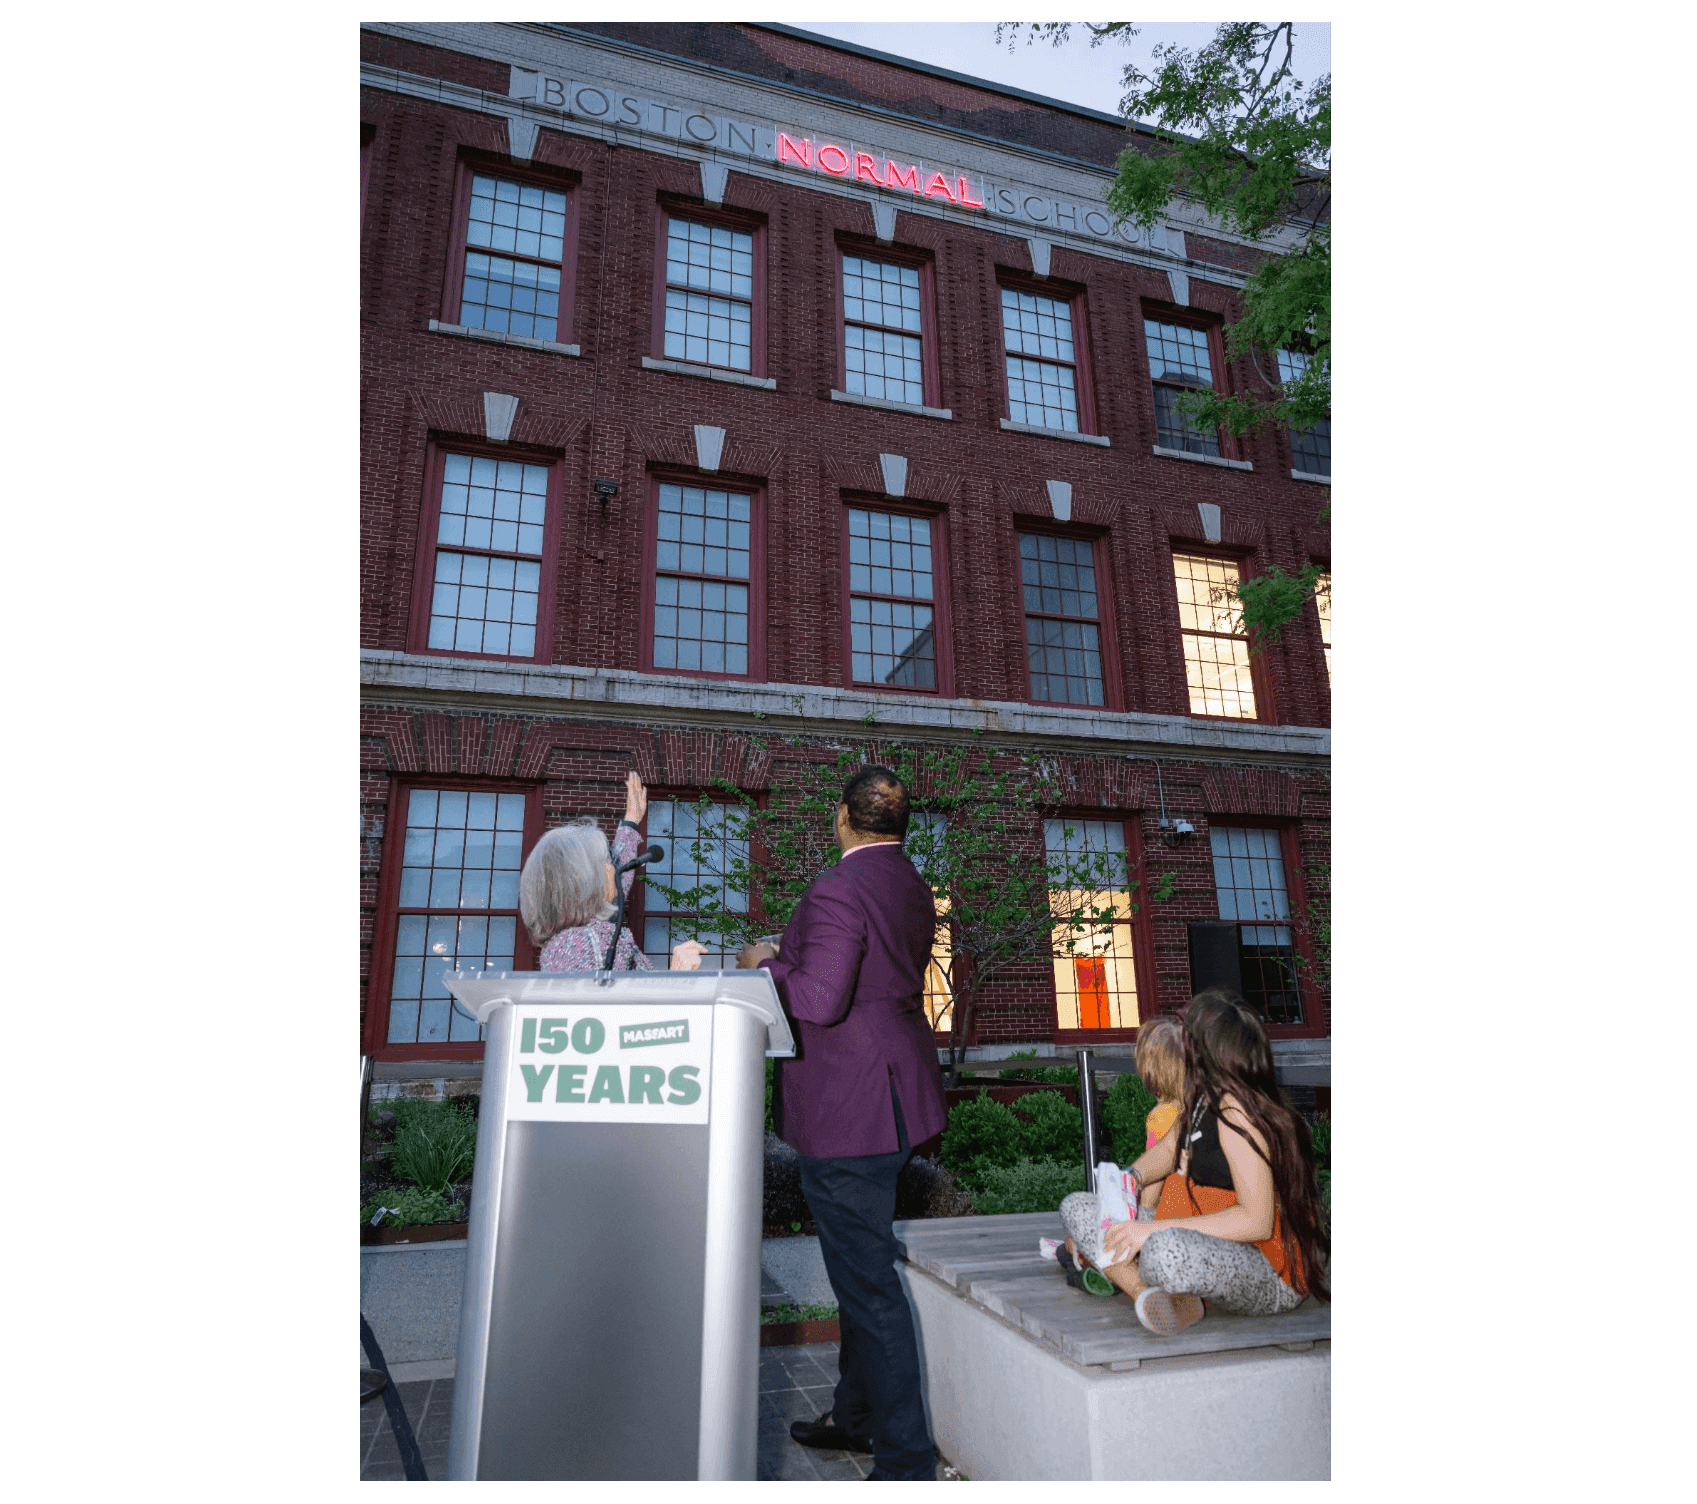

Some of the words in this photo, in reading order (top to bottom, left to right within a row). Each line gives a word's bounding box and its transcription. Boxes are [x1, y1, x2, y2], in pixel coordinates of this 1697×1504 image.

[543, 78, 756, 153] BOSTON
[778, 132, 983, 208] NORMAL
[520, 1017, 605, 1054] 150
[623, 1025, 684, 1043] MASSART
[519, 1064, 702, 1105] YEARS
